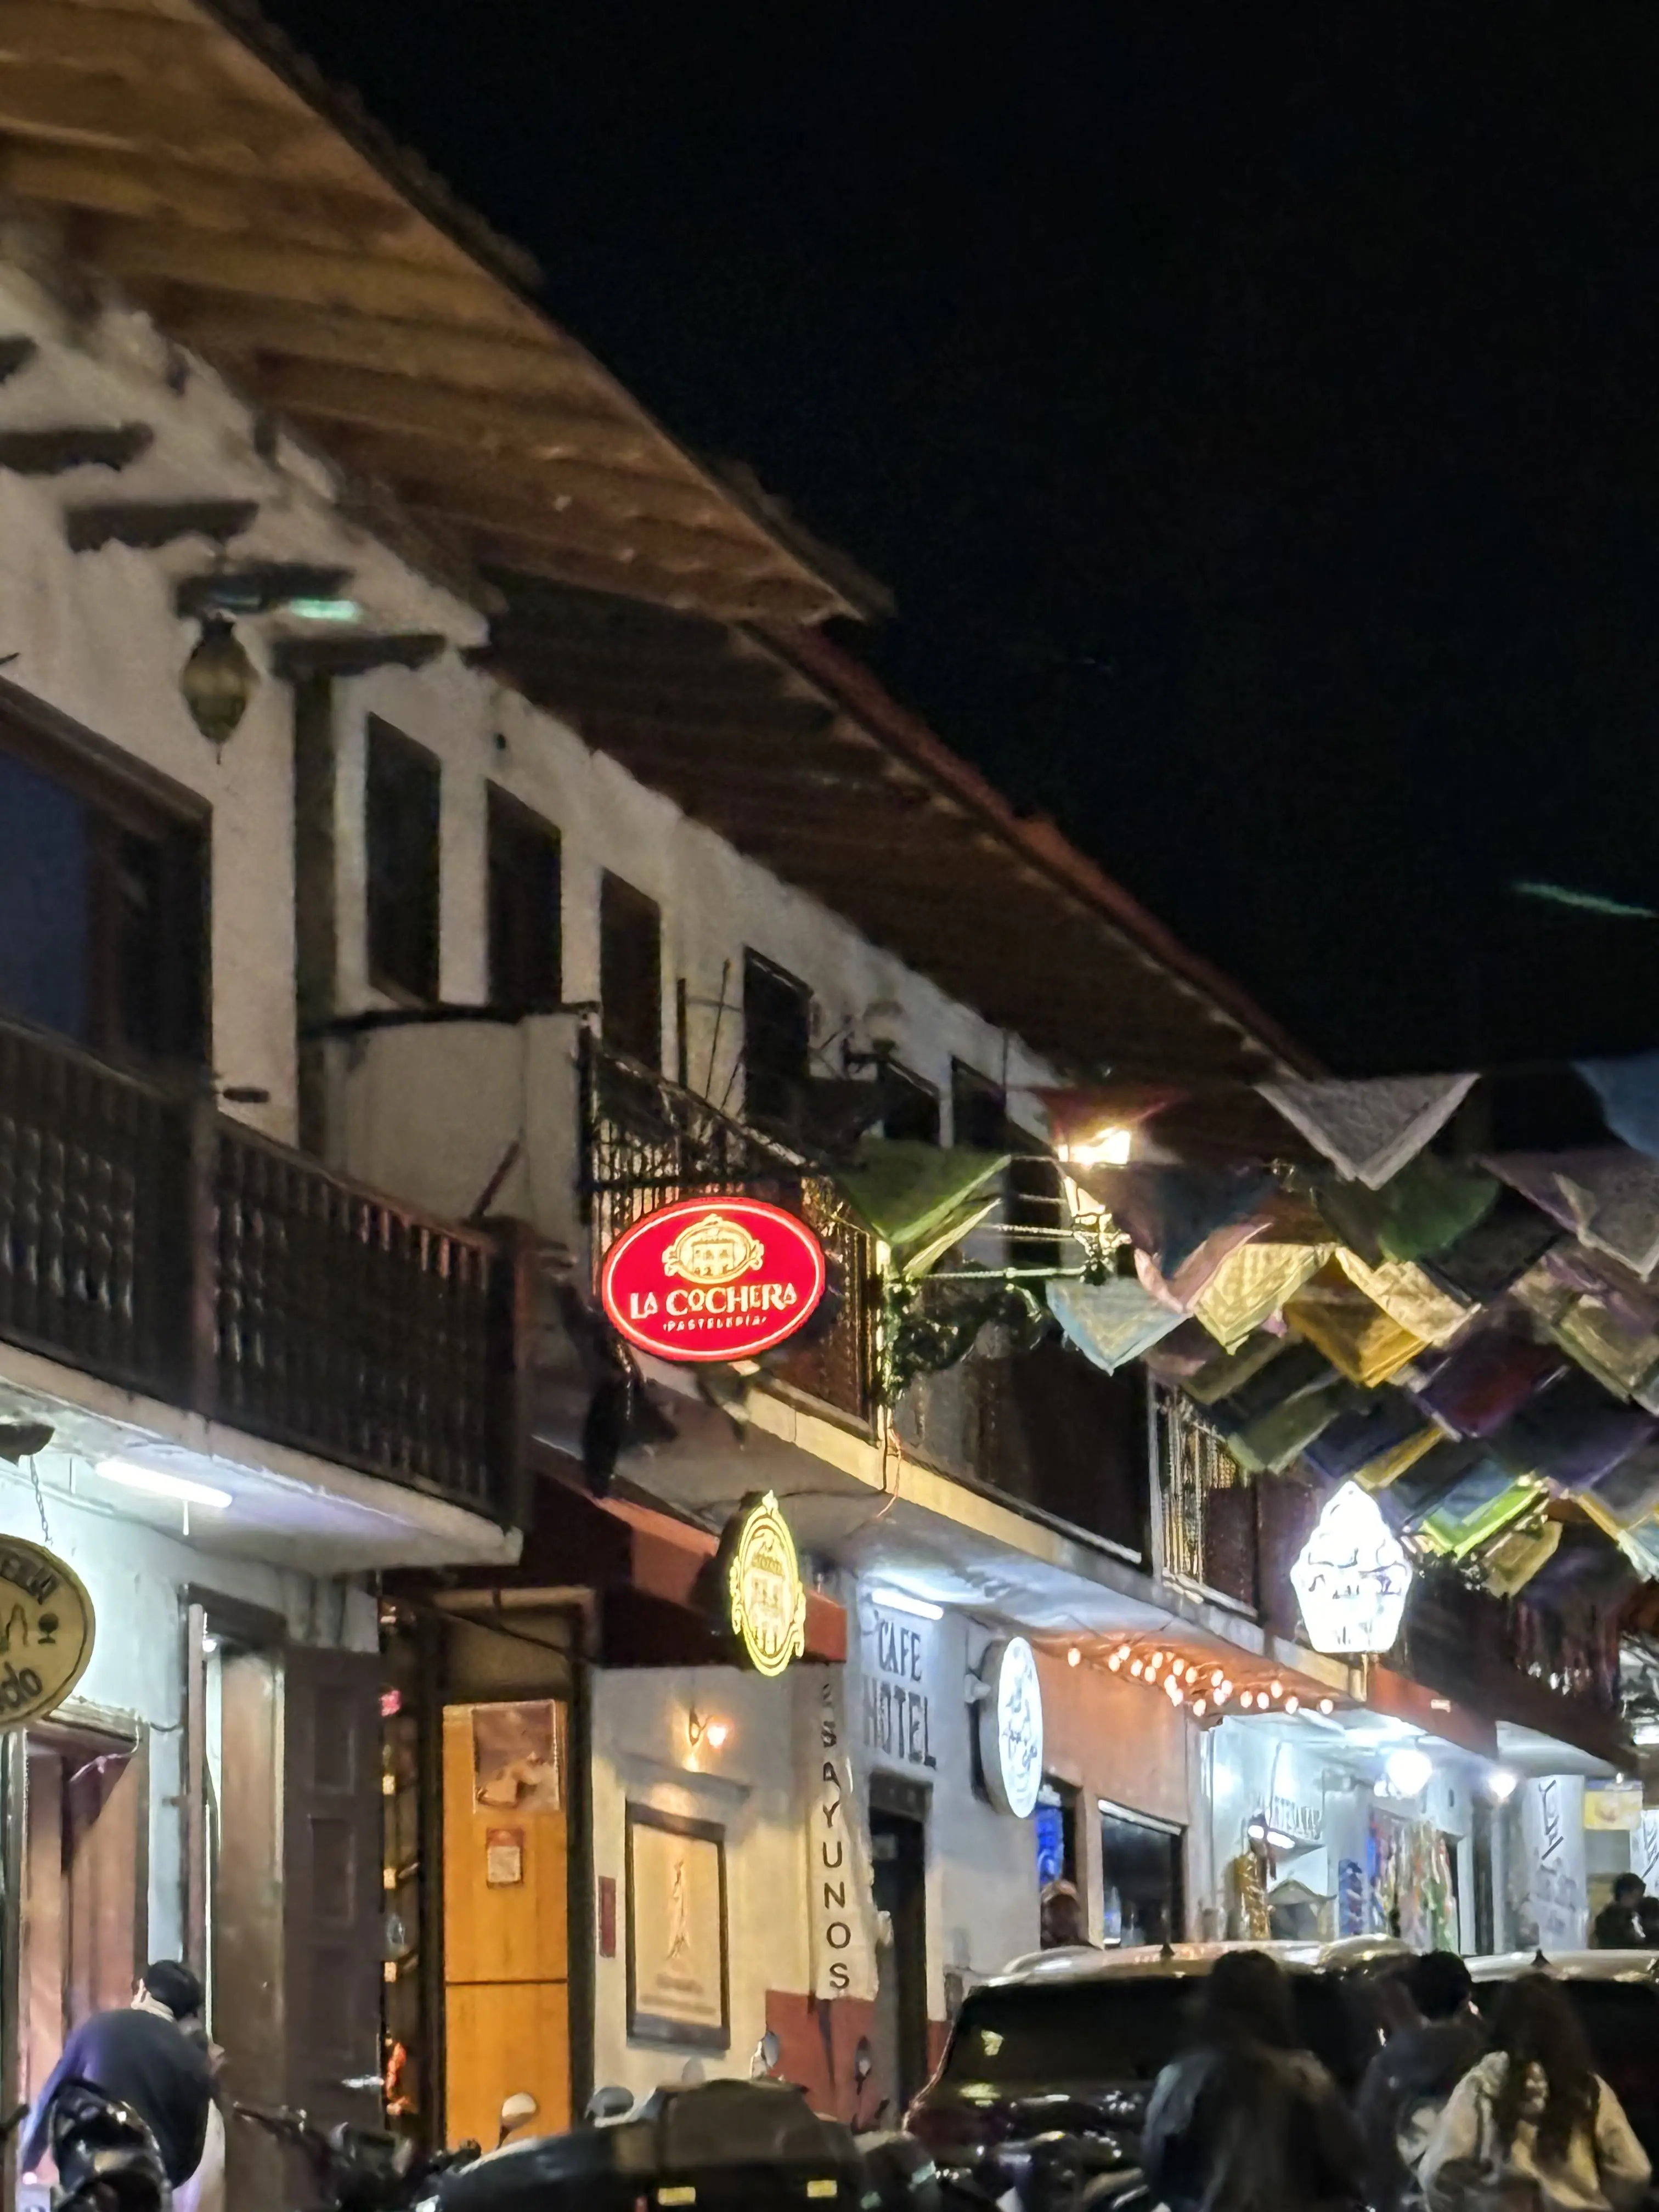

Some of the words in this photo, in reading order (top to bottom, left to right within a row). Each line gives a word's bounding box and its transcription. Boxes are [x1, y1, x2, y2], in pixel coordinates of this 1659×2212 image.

[630, 1291, 658, 1319] LA
[665, 1282, 797, 1316] COCHERA
[863, 1673, 937, 1771] HOTEL
